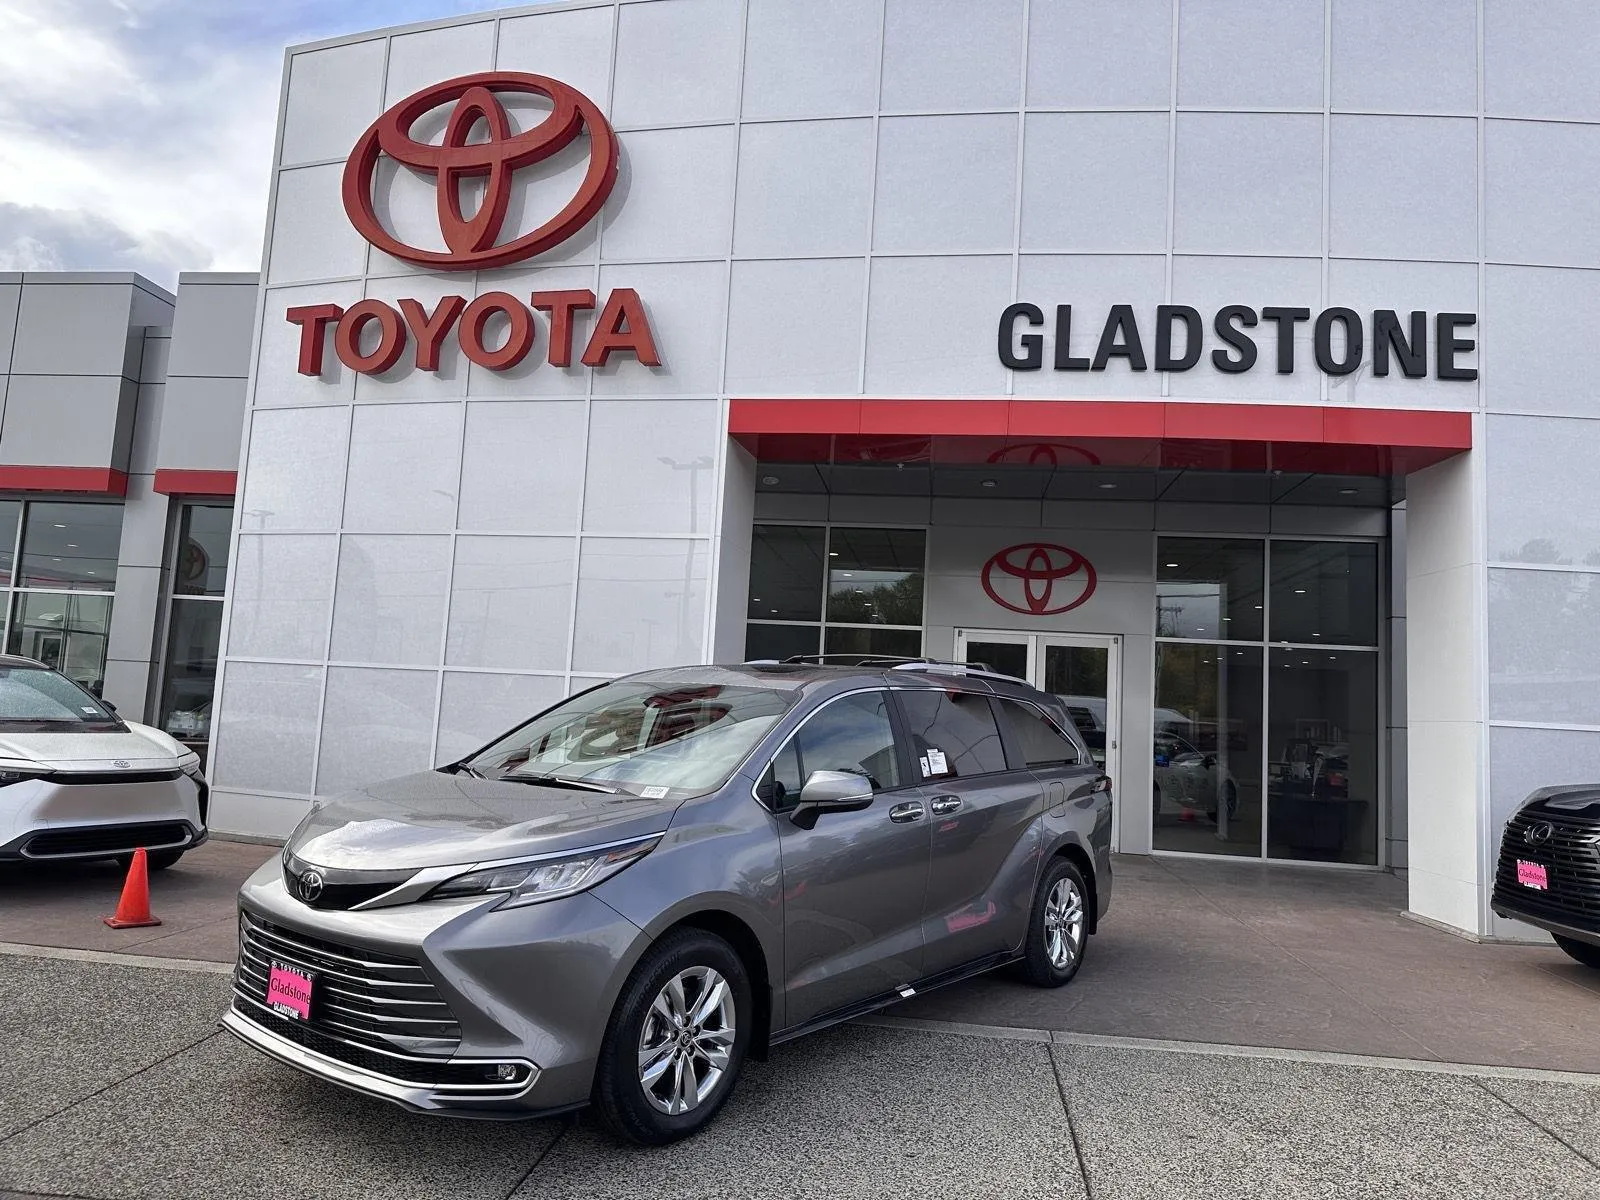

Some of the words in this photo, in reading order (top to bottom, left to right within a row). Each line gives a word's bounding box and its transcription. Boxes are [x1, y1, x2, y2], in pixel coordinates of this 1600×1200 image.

[287, 287, 662, 377] TOYOTA
[998, 302, 1478, 380] GLADSTONE
[280, 962, 304, 978] TOYOTA
[270, 977, 311, 1005] Gladstone
[273, 1001, 300, 1020] GLADSTONE
